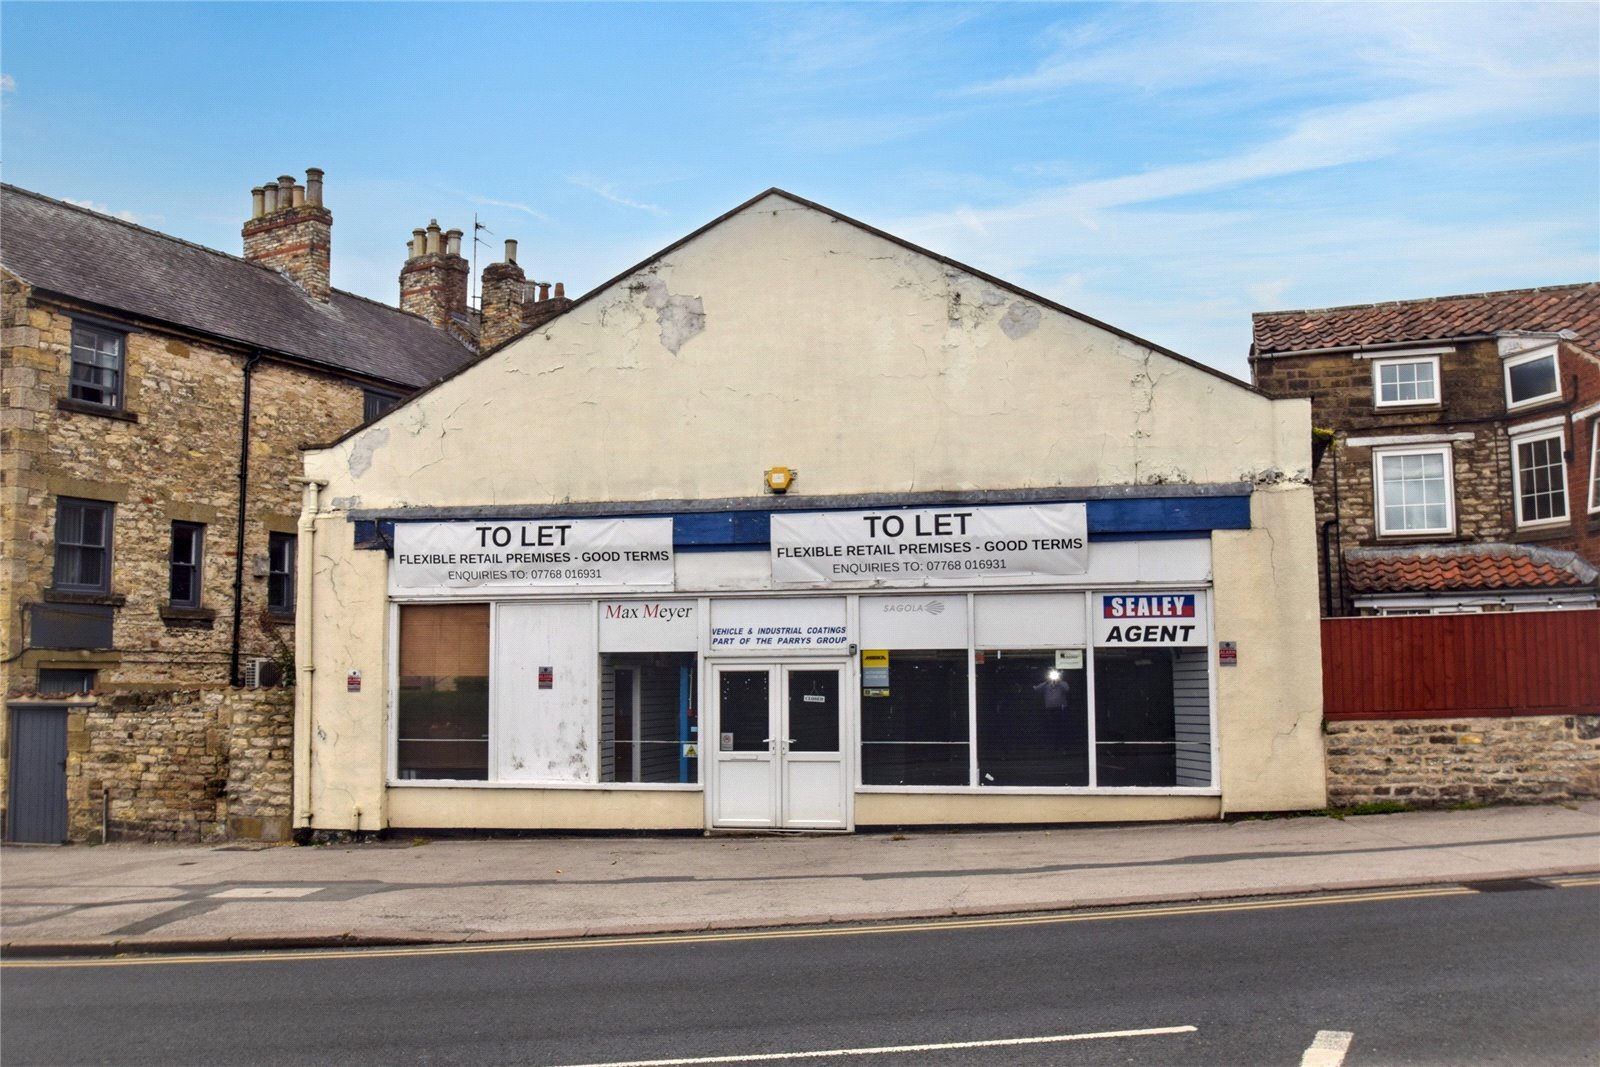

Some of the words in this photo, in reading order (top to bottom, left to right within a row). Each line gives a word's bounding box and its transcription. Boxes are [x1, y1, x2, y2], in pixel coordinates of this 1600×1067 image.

[863, 515, 904, 538] TO
[915, 513, 972, 536] LET
[476, 526, 512, 547] TO
[521, 525, 572, 546] LET
[777, 546, 842, 558] FLEXIBLE
[847, 544, 895, 556] RETAIL
[899, 542, 971, 555] PREMISES
[984, 540, 1027, 552] GOOD
[1032, 538, 1082, 550] TERMS
[399, 554, 456, 564] FLEXIBLE
[460, 553, 503, 563] RETAIL
[506, 553, 571, 563] PREMISES
[582, 552, 620, 562] GOOD
[624, 551, 669, 561] TERMS
[833, 562, 900, 574] ENQUIRIES
[903, 561, 923, 571] TO:
[926, 560, 961, 570] 07768
[965, 559, 1006, 570] 016931
[449, 570, 507, 581] ENQUIRIES
[510, 570, 528, 579] TO:
[531, 570, 561, 579] 07768
[565, 569, 601, 578] 016931
[605, 605, 638, 619] Max
[643, 604, 692, 621] Meyer
[883, 604, 924, 613] SAGOLA
[1111, 596, 1186, 616] SEALEY
[807, 626, 846, 634] COATINGS
[1106, 625, 1195, 642] AGENT
[712, 637, 734, 645] PART
[817, 636, 847, 644] GROUP
